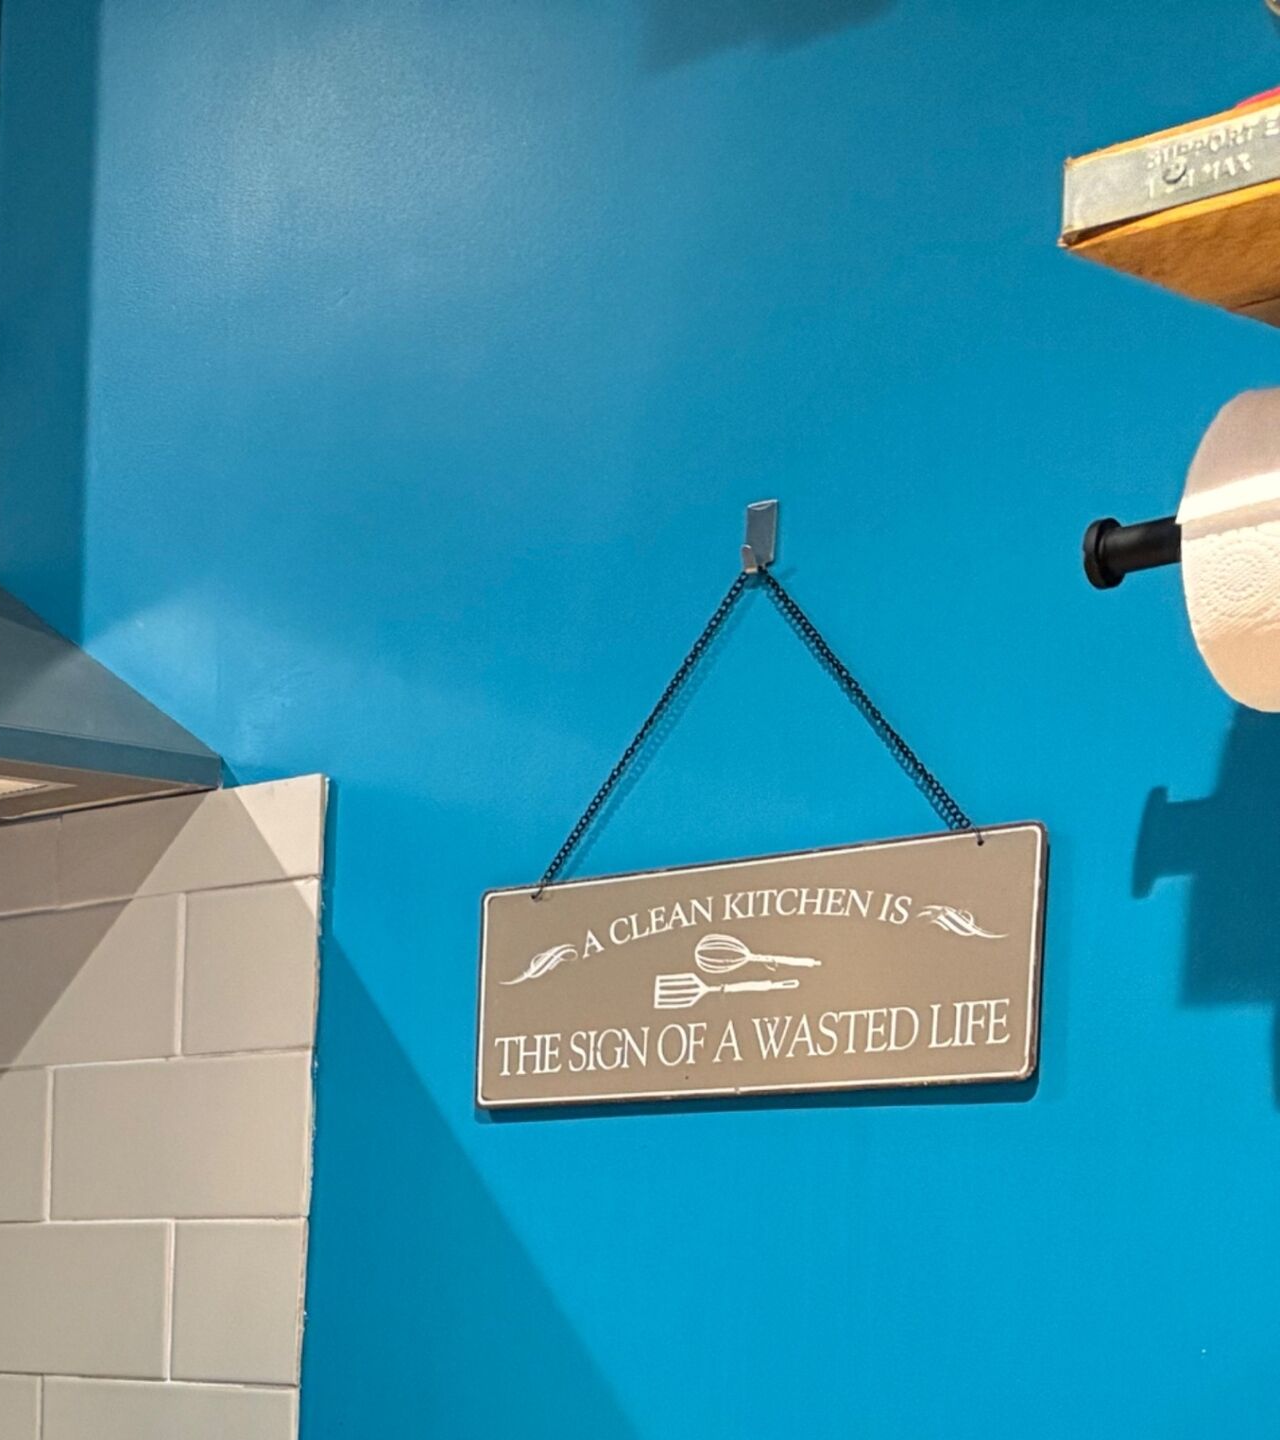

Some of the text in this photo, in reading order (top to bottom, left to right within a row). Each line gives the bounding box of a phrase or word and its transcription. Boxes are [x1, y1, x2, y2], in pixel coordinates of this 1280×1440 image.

[581, 887, 913, 959] A CLEAN KITCHEN IS
[493, 998, 1011, 1078] THE SIGN OF A WASTED LIFE
